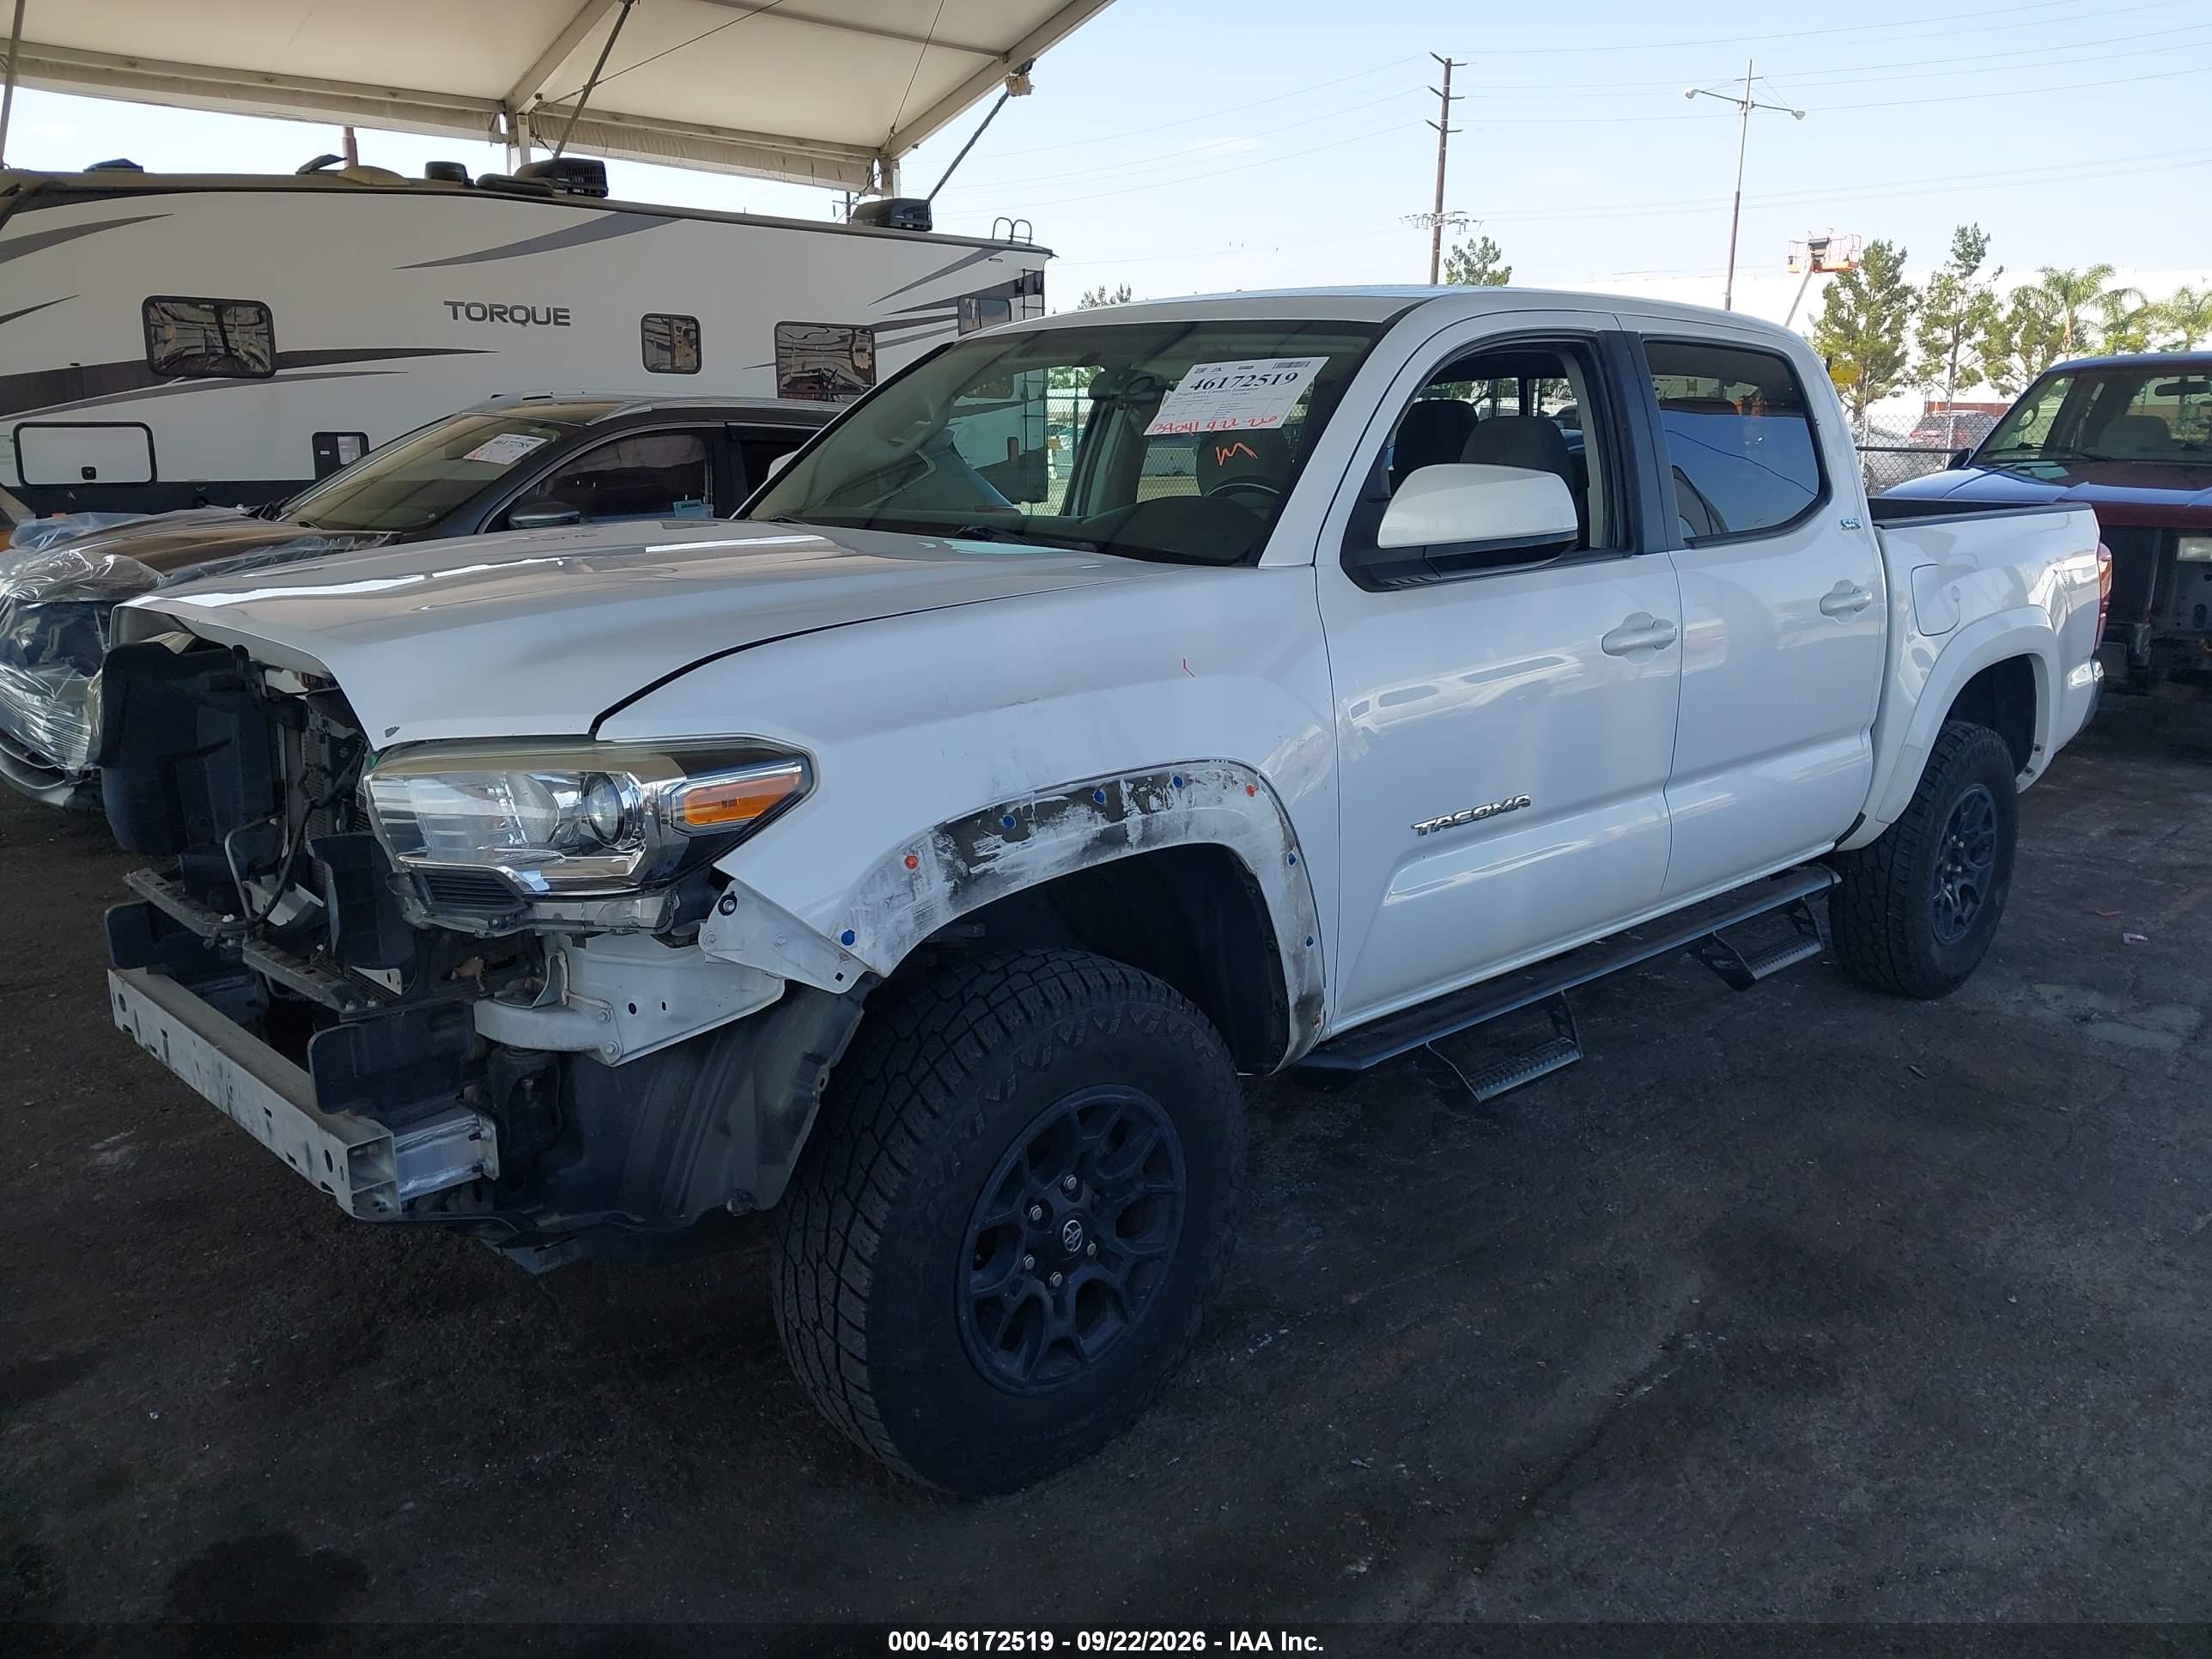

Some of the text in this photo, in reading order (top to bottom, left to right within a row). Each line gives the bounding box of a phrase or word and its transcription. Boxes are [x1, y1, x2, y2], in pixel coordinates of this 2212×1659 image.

[443, 301, 571, 327] TORQUE
[1189, 372, 1299, 391] 46172519
[1411, 793, 1532, 836] TACOMA
